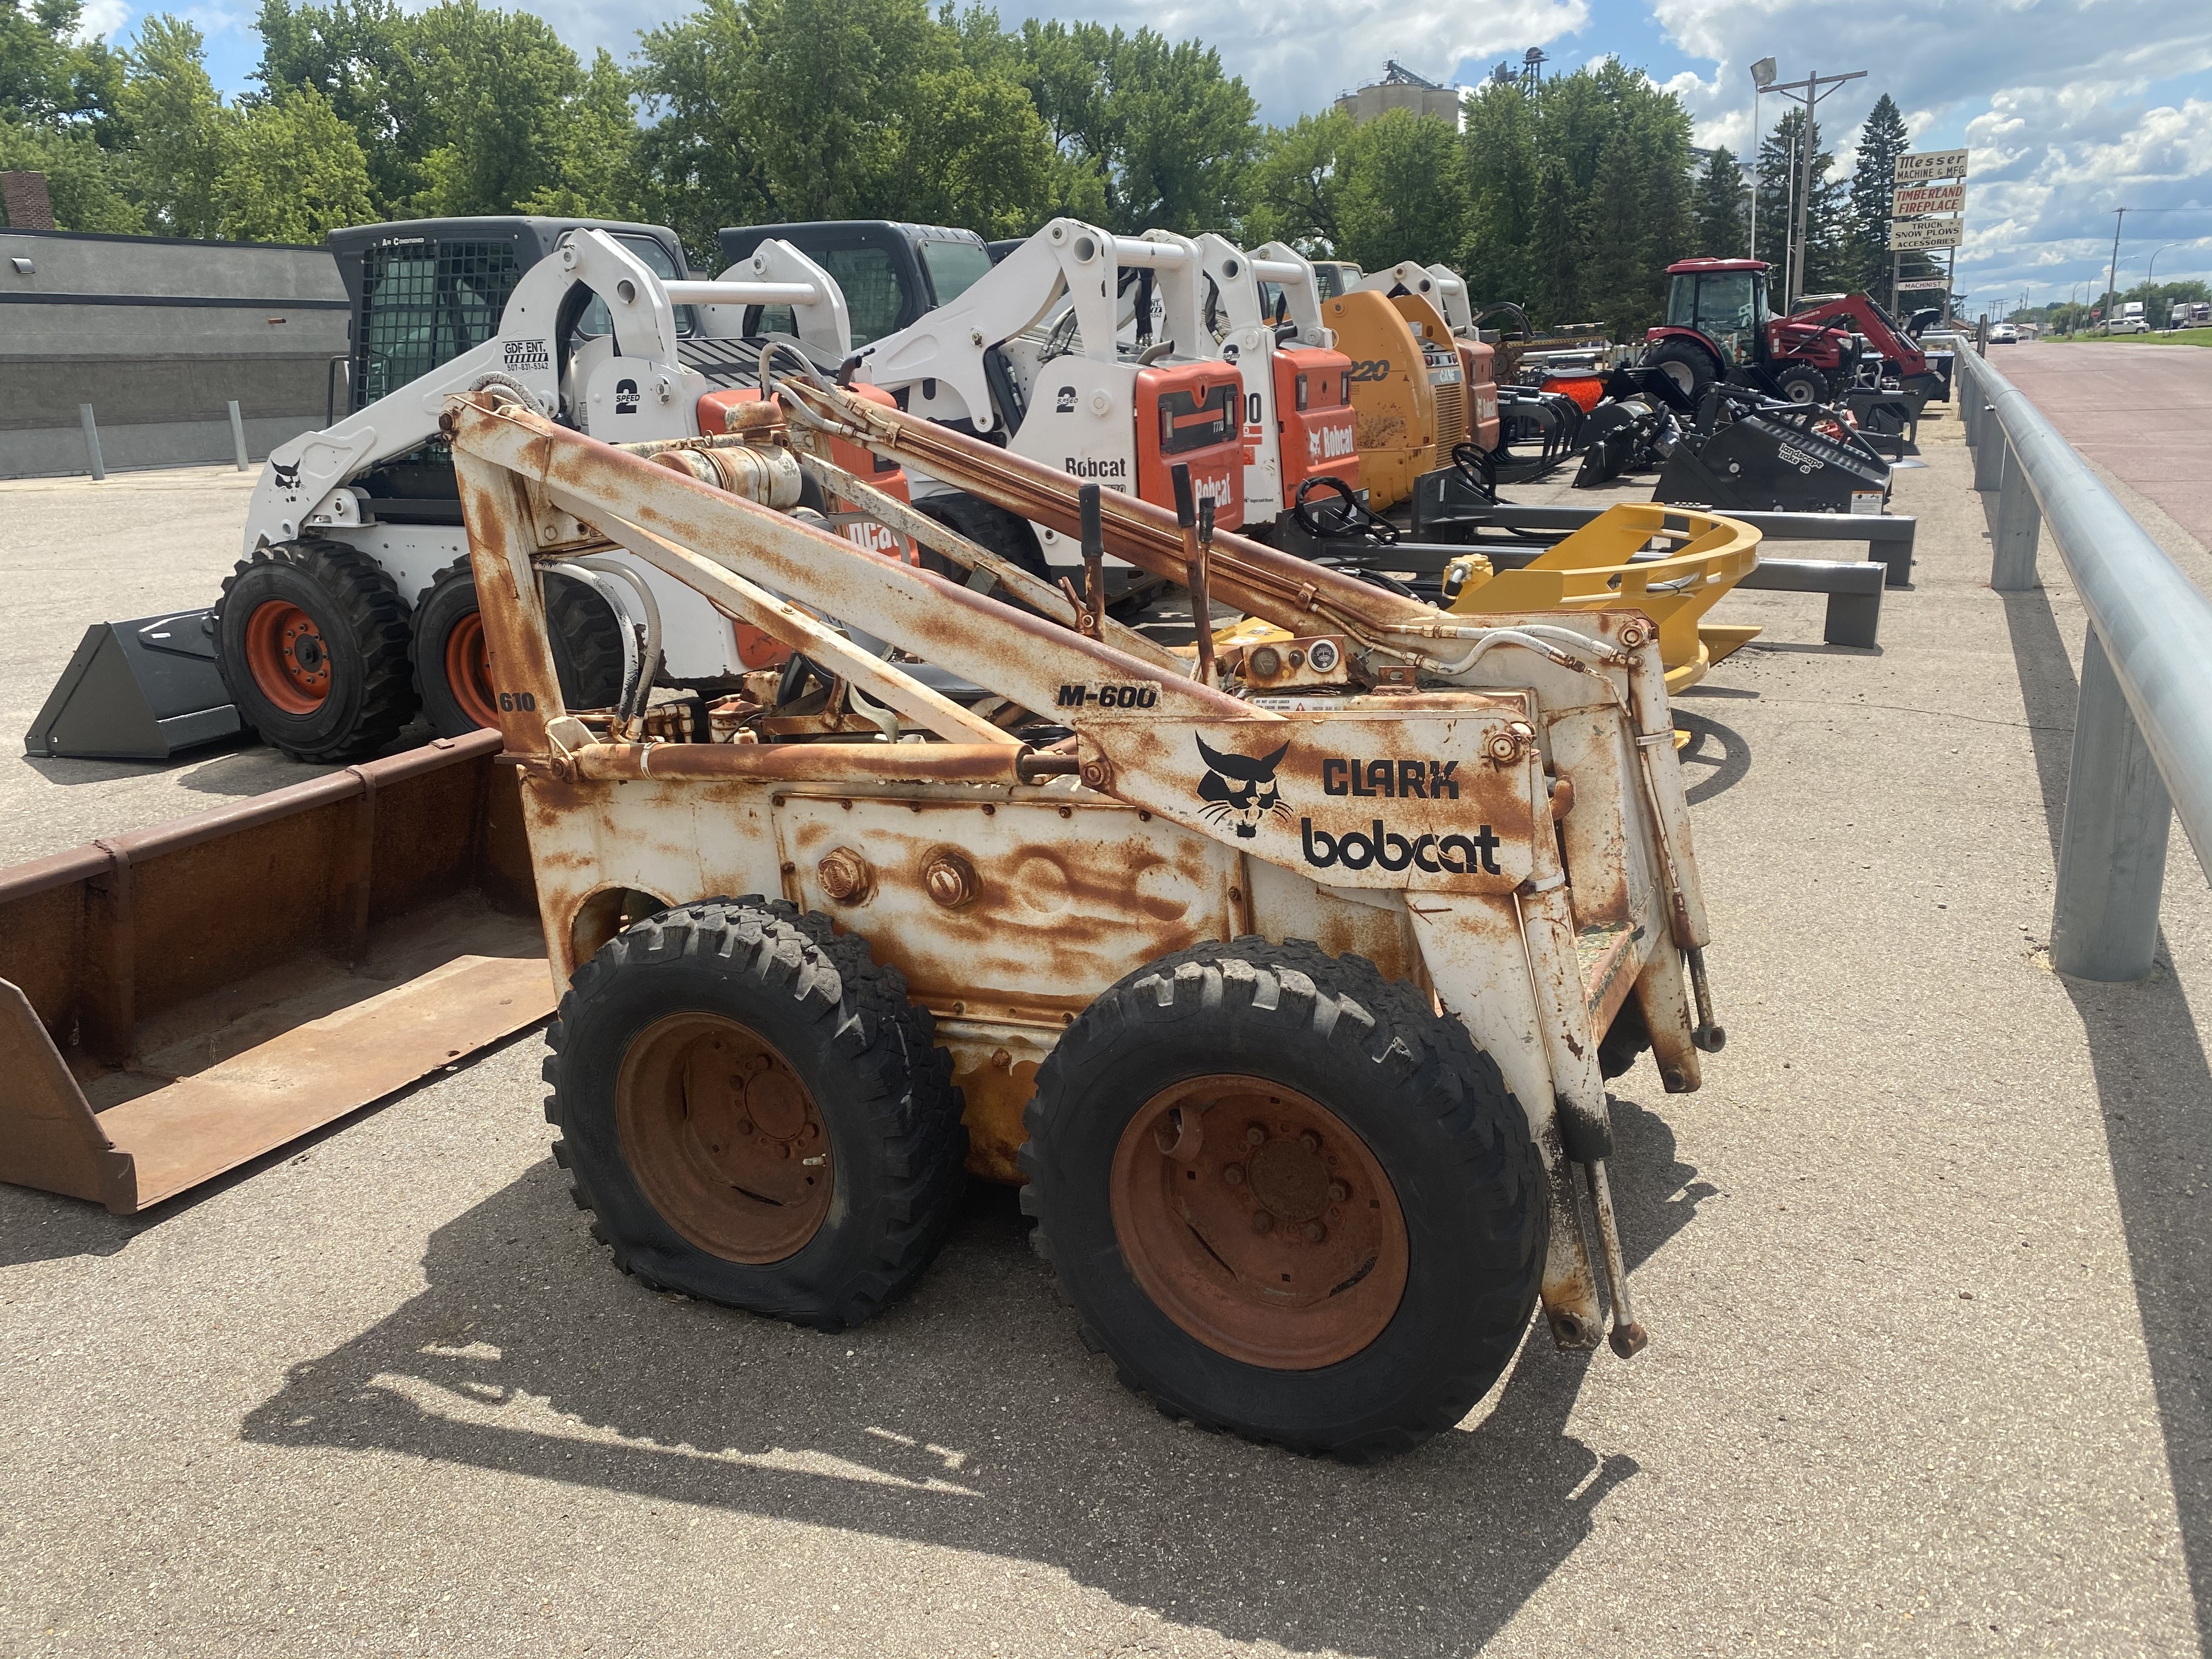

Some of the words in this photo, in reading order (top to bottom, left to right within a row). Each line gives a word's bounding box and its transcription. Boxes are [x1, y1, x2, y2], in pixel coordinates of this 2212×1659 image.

[1899, 155, 1965, 169] Messer
[1897, 168, 1934, 180] MACHINE
[1946, 166, 1966, 176] MFG.
[1897, 186, 1963, 202] TIMBERLAND
[1898, 199, 1959, 213] FIREPLACE
[1895, 230, 1922, 239] SNOW
[1926, 227, 1960, 236] PLOWS
[1912, 222, 1943, 230] TRUCK
[1897, 238, 1956, 248] ACCESSORIES
[1905, 281, 1942, 290] MACHINIST
[505, 342, 523, 354] GDF
[526, 341, 546, 353] ENT.
[507, 362, 549, 371] 507-831-5342
[616, 379, 637, 414] 2
[1056, 386, 1076, 413] 2
[1213, 420, 1224, 433] T770
[1323, 425, 1355, 458] Bobcat
[1780, 444, 1822, 467] landscape
[1780, 452, 1798, 464] rake
[1065, 457, 1126, 477] Bobcat
[500, 692, 535, 712] 610
[1058, 685, 1157, 708] M-600
[1323, 759, 1459, 799] CLARK
[1301, 817, 1501, 875] bobcat
